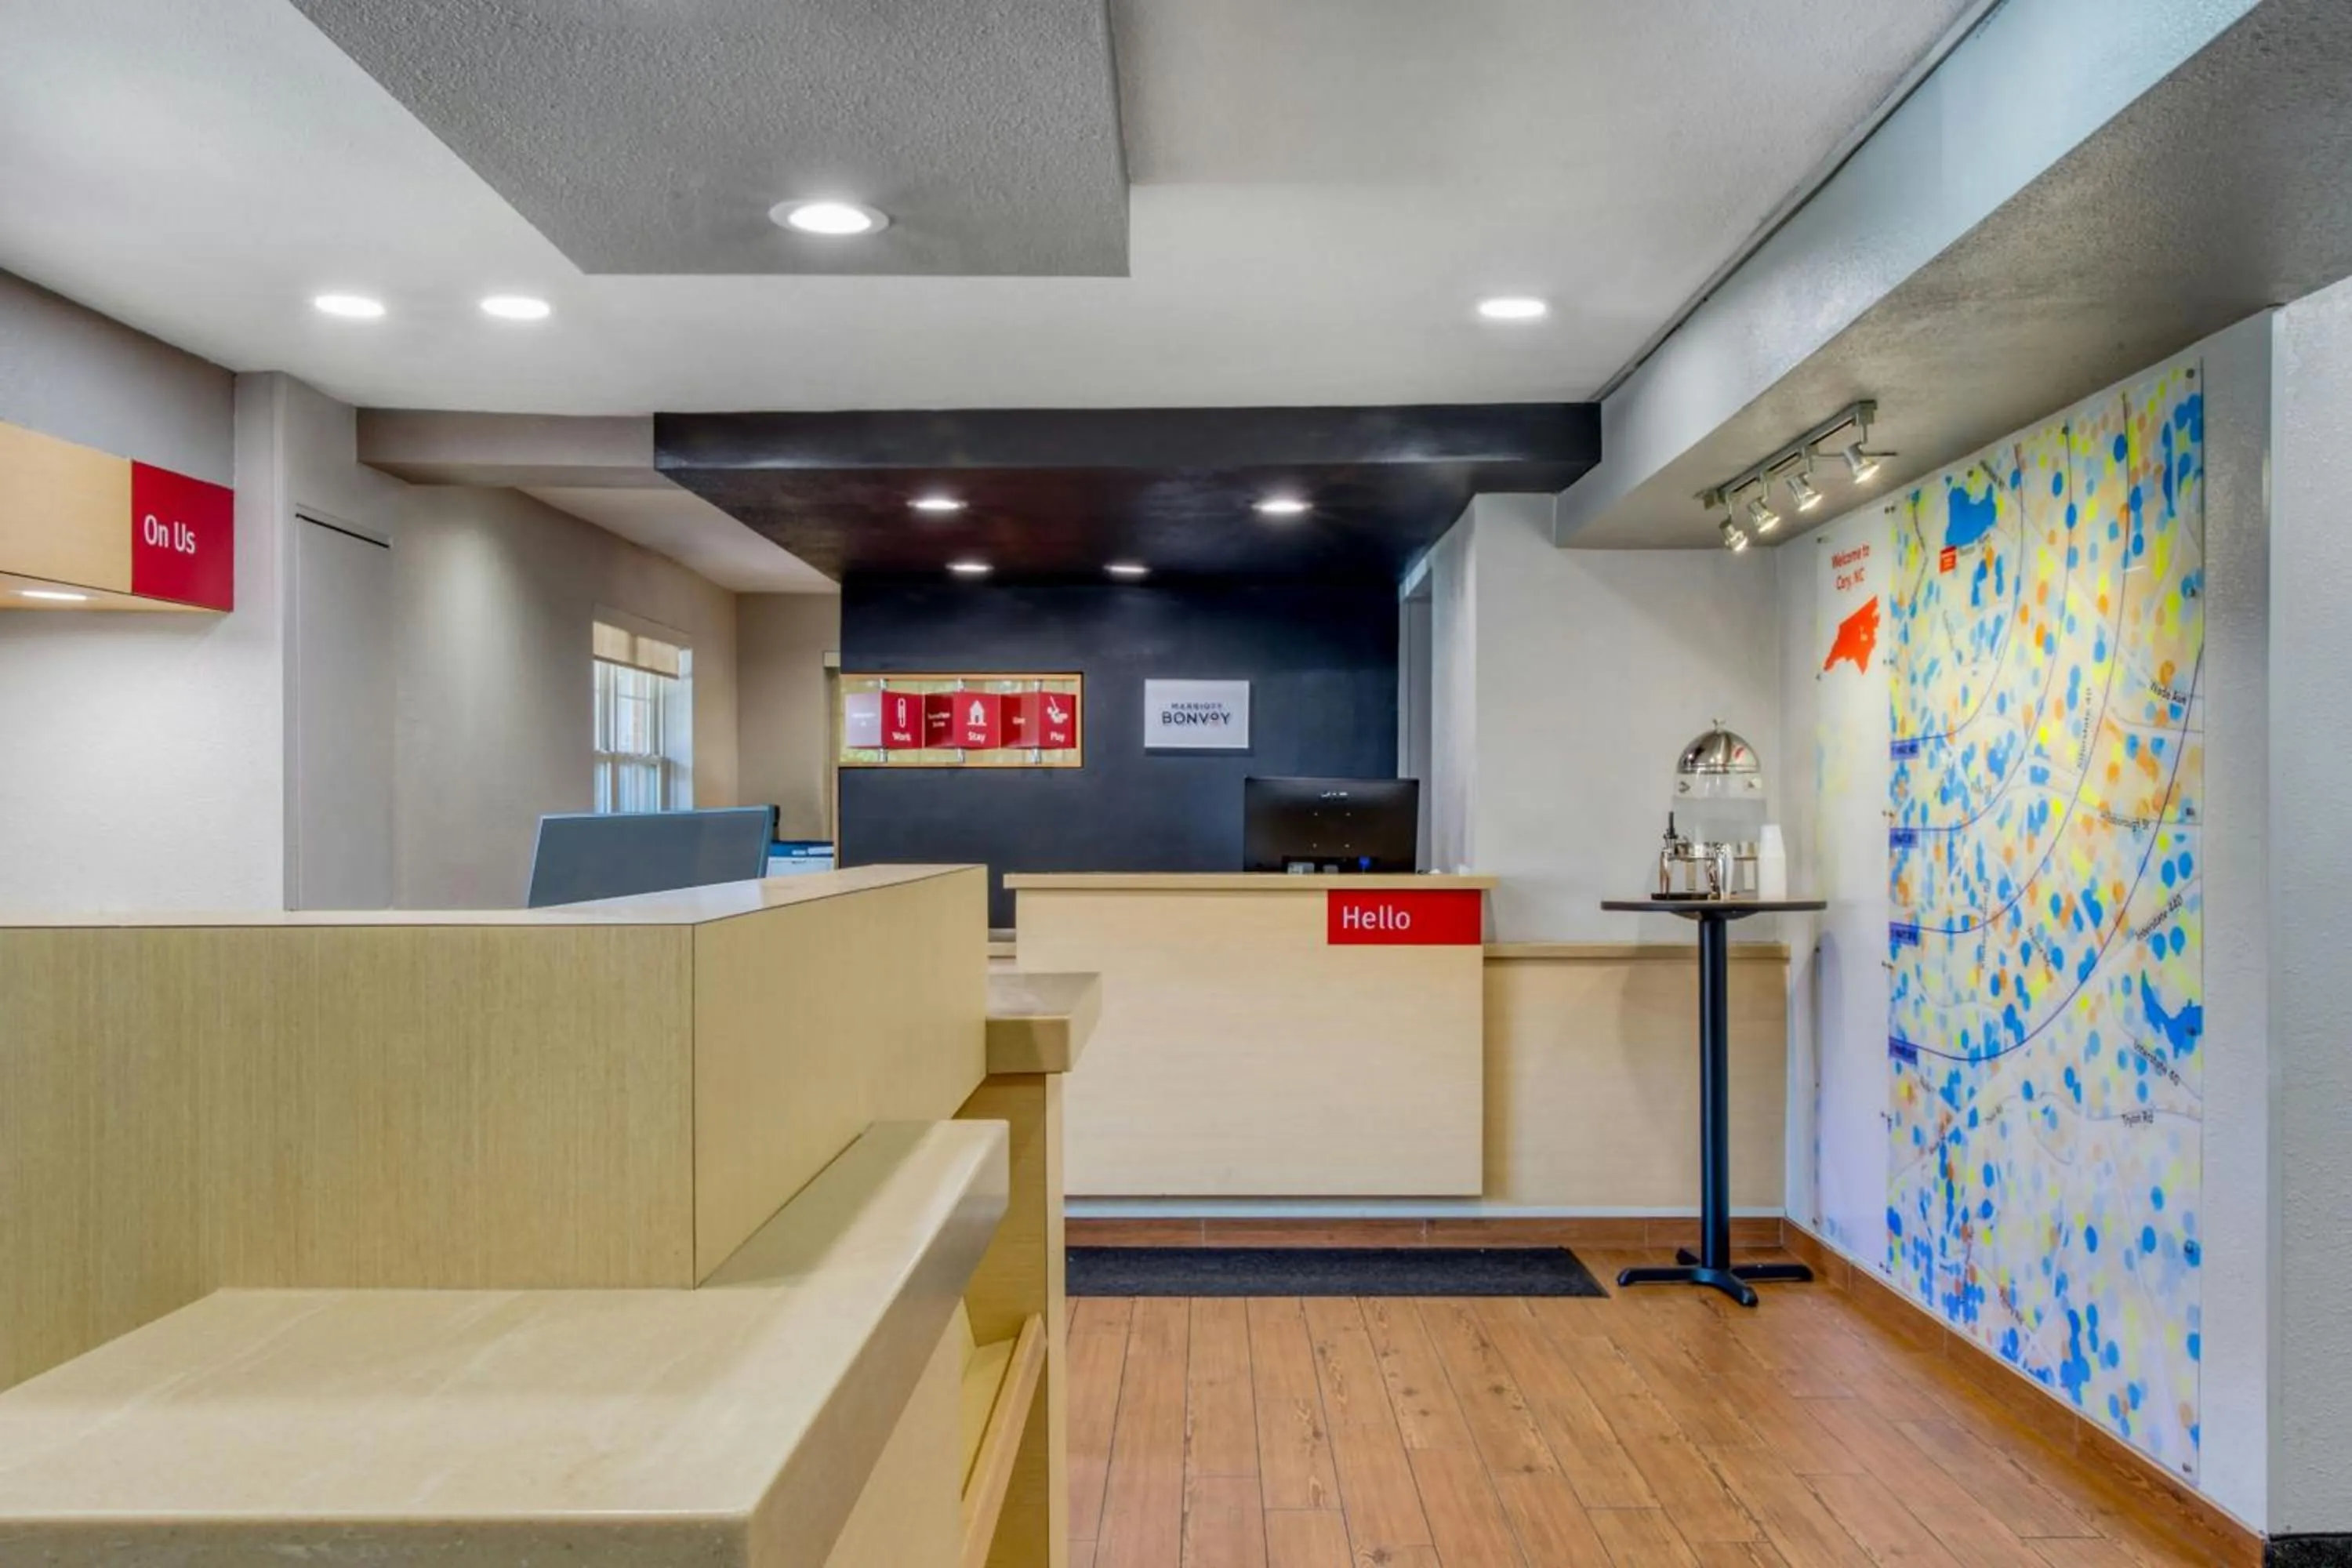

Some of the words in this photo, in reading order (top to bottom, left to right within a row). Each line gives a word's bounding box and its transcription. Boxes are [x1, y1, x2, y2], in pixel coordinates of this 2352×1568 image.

[143, 514, 169, 548] On
[173, 521, 196, 554] Us
[1161, 711, 1230, 725] BONVOY
[891, 731, 912, 742] Work
[967, 731, 986, 744] Stay
[1342, 905, 1411, 930] Hello
